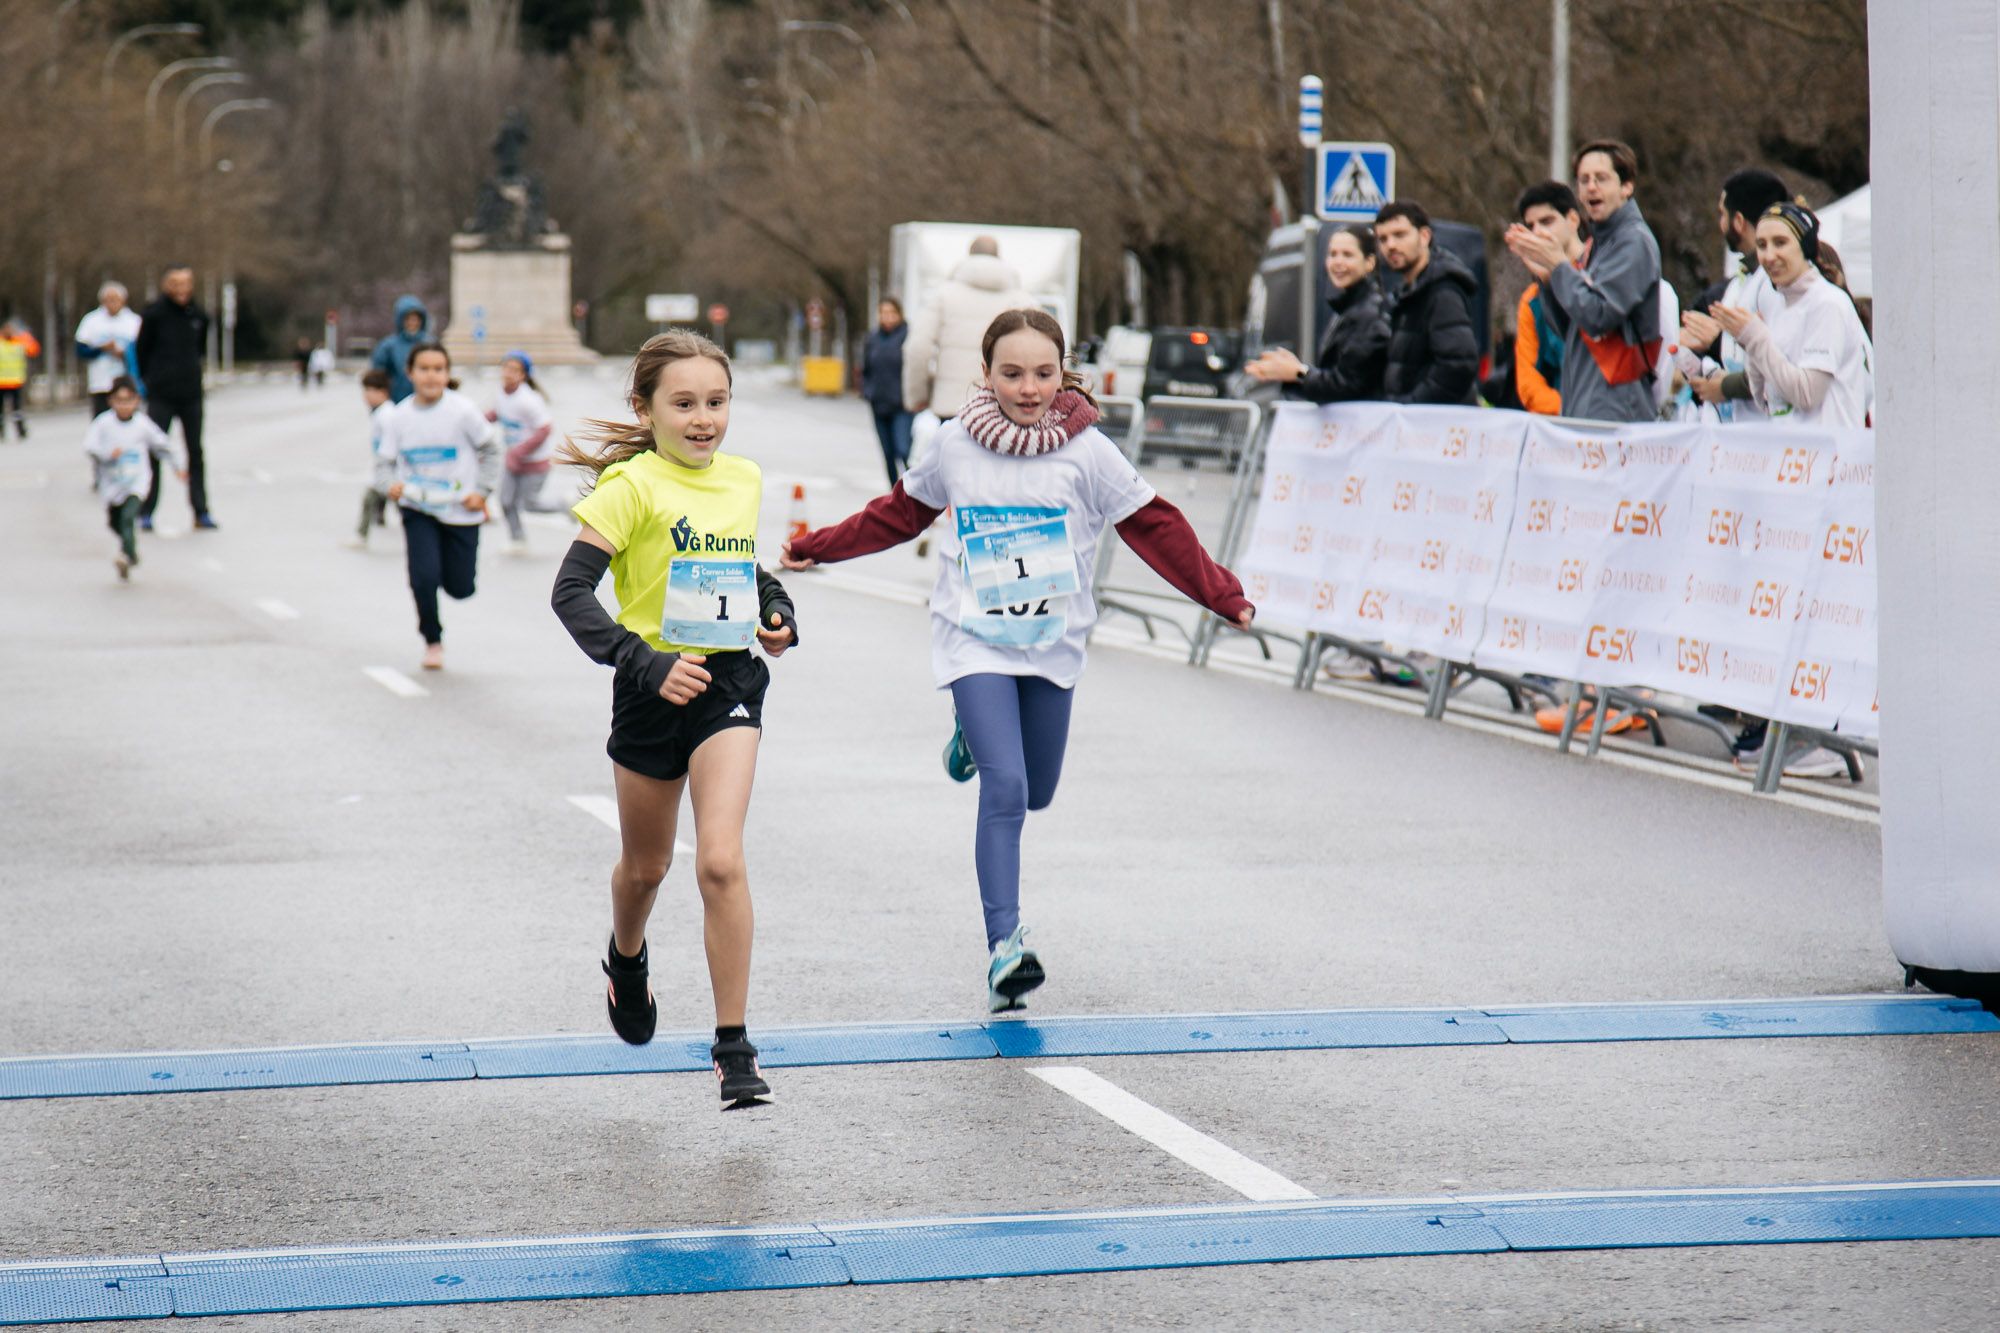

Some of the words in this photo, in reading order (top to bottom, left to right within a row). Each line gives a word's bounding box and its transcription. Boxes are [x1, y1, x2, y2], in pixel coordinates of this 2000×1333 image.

[1777, 447, 1819, 485] GSK
[973, 512, 1006, 524] Carrera
[1527, 499, 1556, 532] GSK
[1613, 500, 1667, 537] GSK
[1708, 508, 1744, 547] GSK
[1823, 522, 1870, 566] GSK
[1014, 557, 1029, 579] 1
[716, 595, 729, 621] 1
[1557, 559, 1590, 592] GSK
[1749, 579, 1789, 620] GSK
[1500, 616, 1528, 650] GSK
[1586, 624, 1637, 663] GSK
[1677, 636, 1711, 677] GSK
[1790, 660, 1831, 702] GSK
